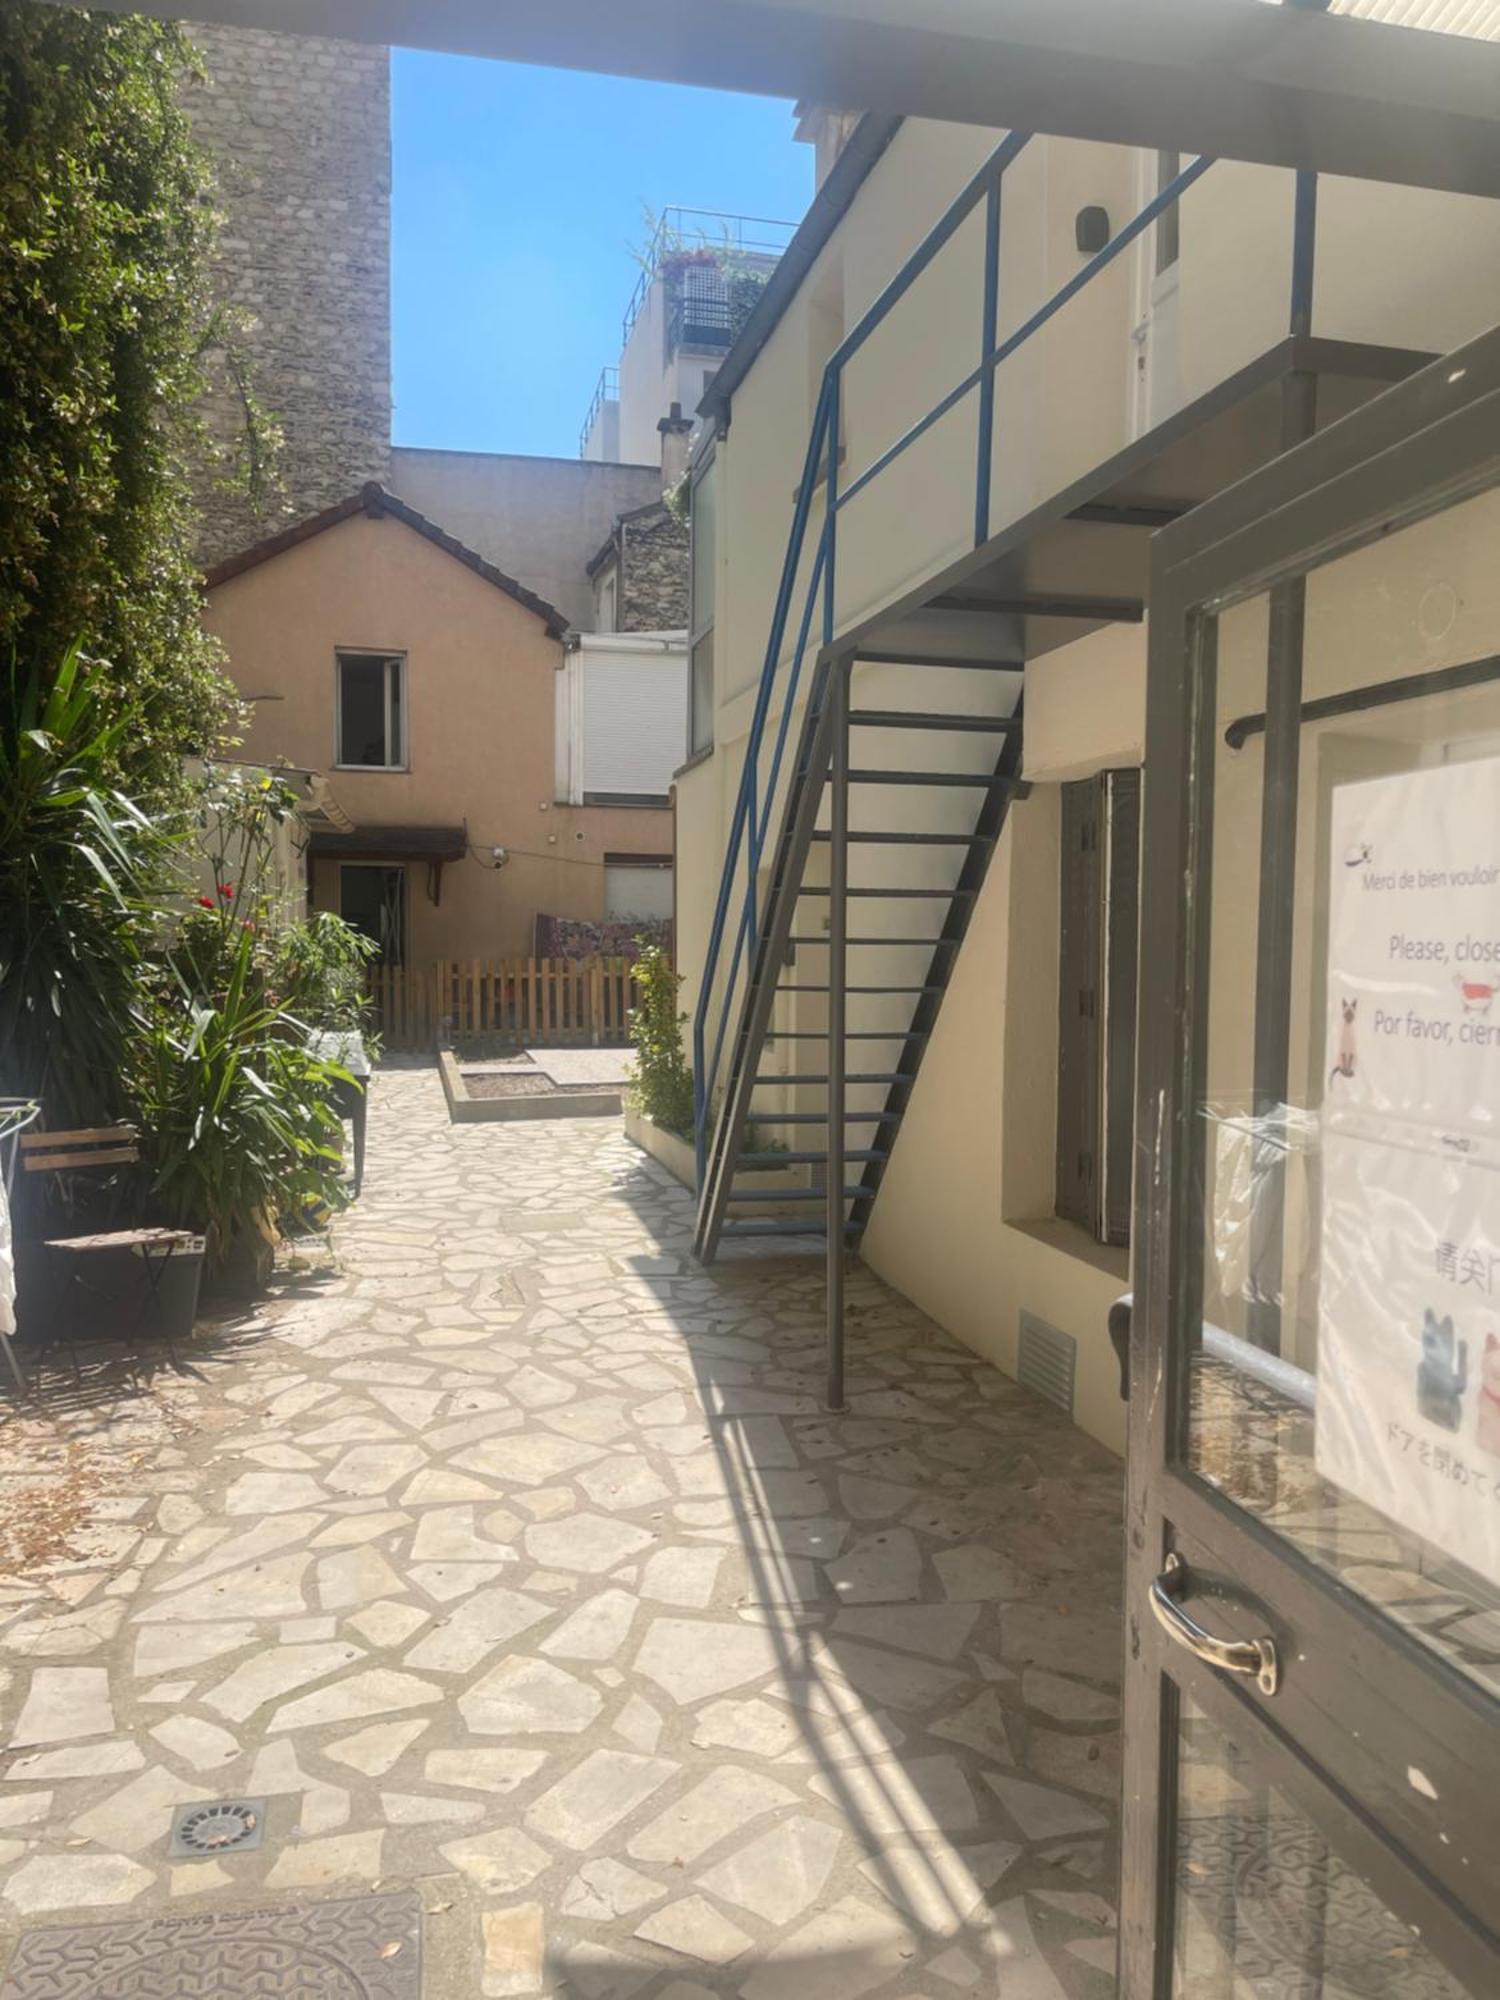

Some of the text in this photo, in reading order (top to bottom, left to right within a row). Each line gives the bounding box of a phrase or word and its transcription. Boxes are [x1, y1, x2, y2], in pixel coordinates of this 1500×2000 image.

[1363, 863, 1500, 891] Merci de bien vouloir
[1389, 932, 1500, 965] Please, close
[1374, 1009, 1402, 1036] Por
[1406, 1009, 1453, 1046] favor,
